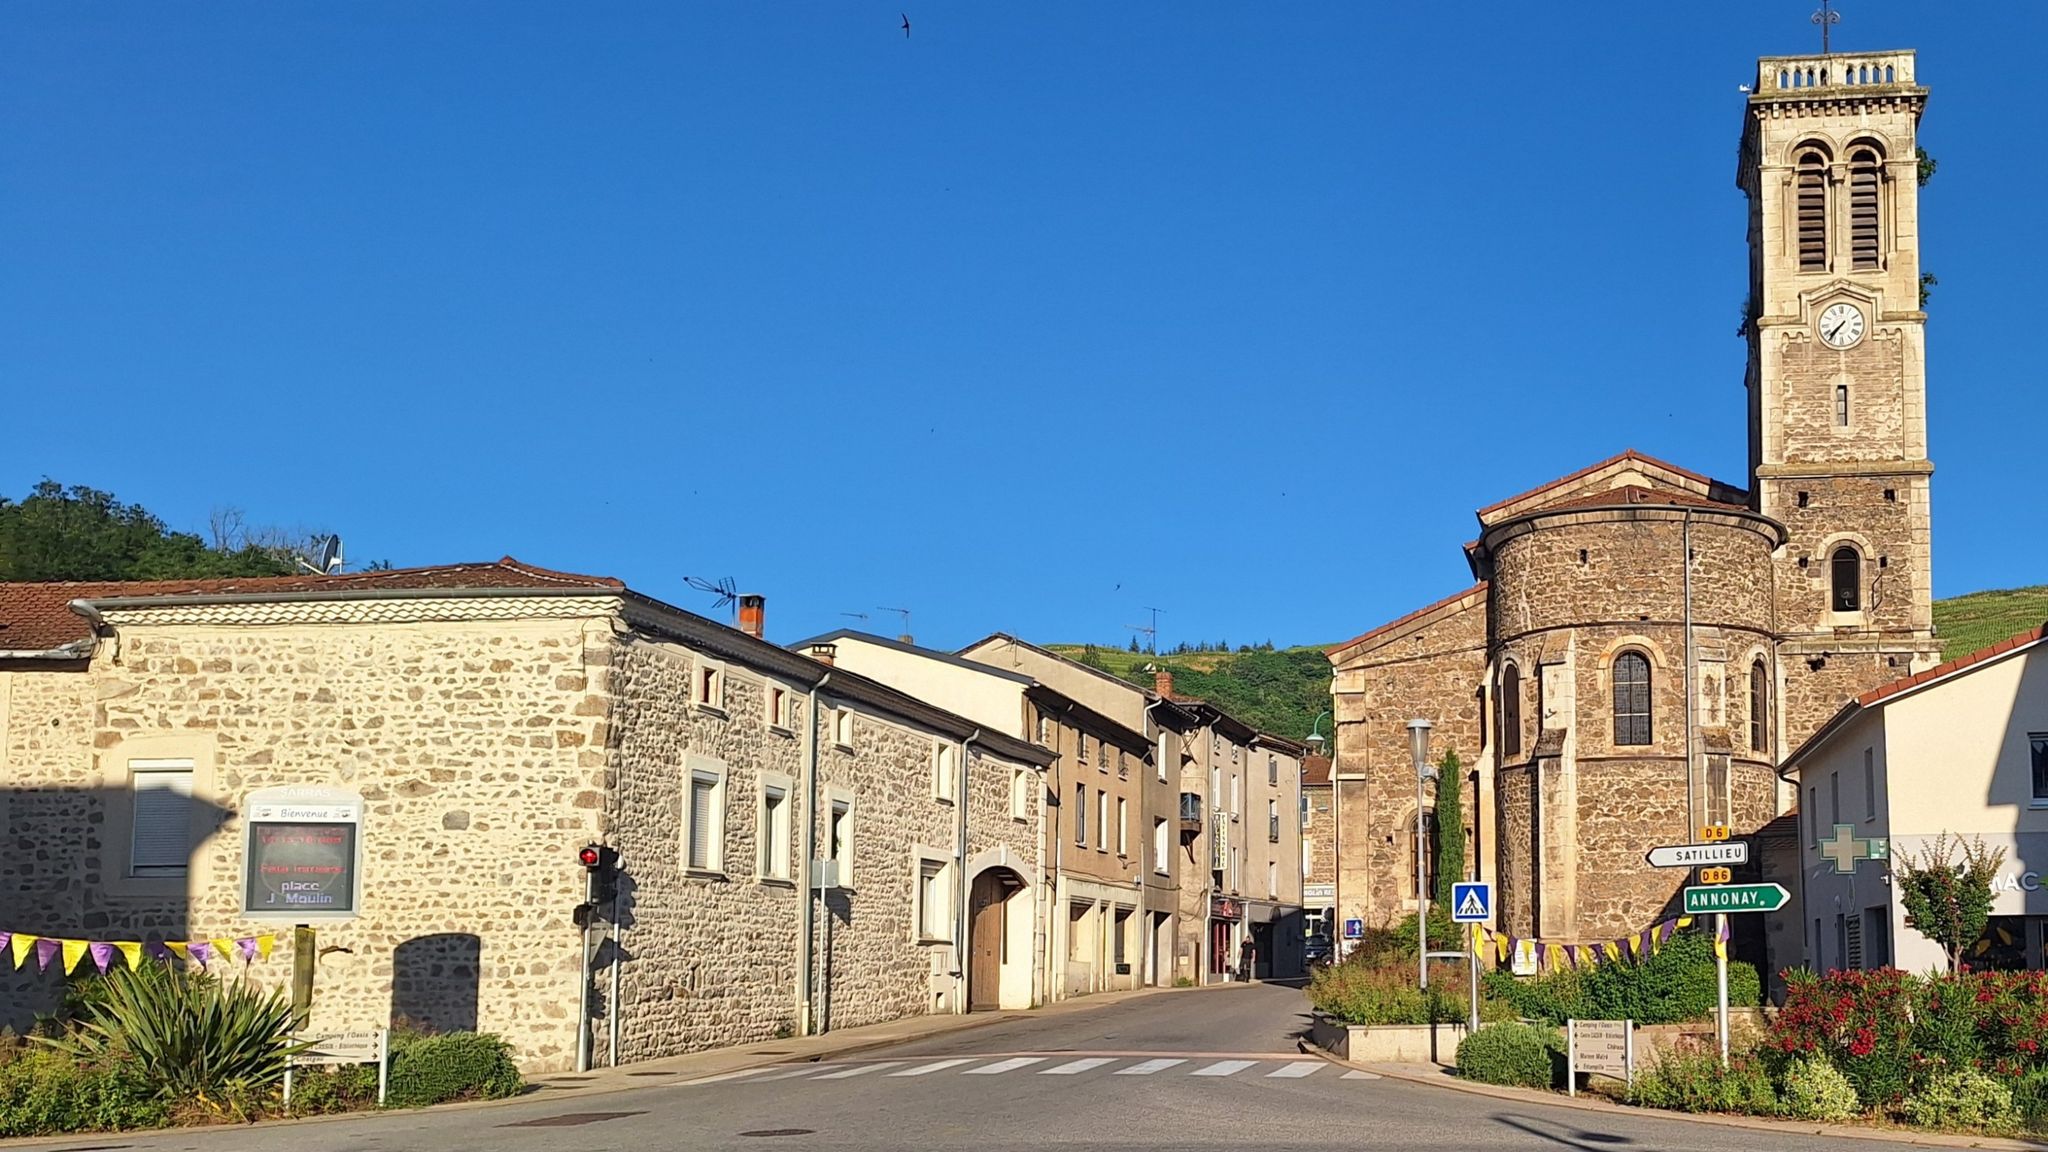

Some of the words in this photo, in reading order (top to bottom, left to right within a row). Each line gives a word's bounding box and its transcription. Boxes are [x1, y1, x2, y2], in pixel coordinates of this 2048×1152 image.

[279, 787, 330, 797] SARRAS
[280, 809, 328, 818] Bienvenue
[1706, 829, 1712, 838] D
[1716, 828, 1723, 837] 6
[1676, 848, 1741, 861] SATILLIEU
[1703, 871, 1709, 881] D
[1713, 870, 1728, 880] 86
[281, 881, 320, 894] place
[265, 893, 275, 904] J
[285, 892, 332, 904] Moulin
[1691, 892, 1758, 906] ANNONAY
